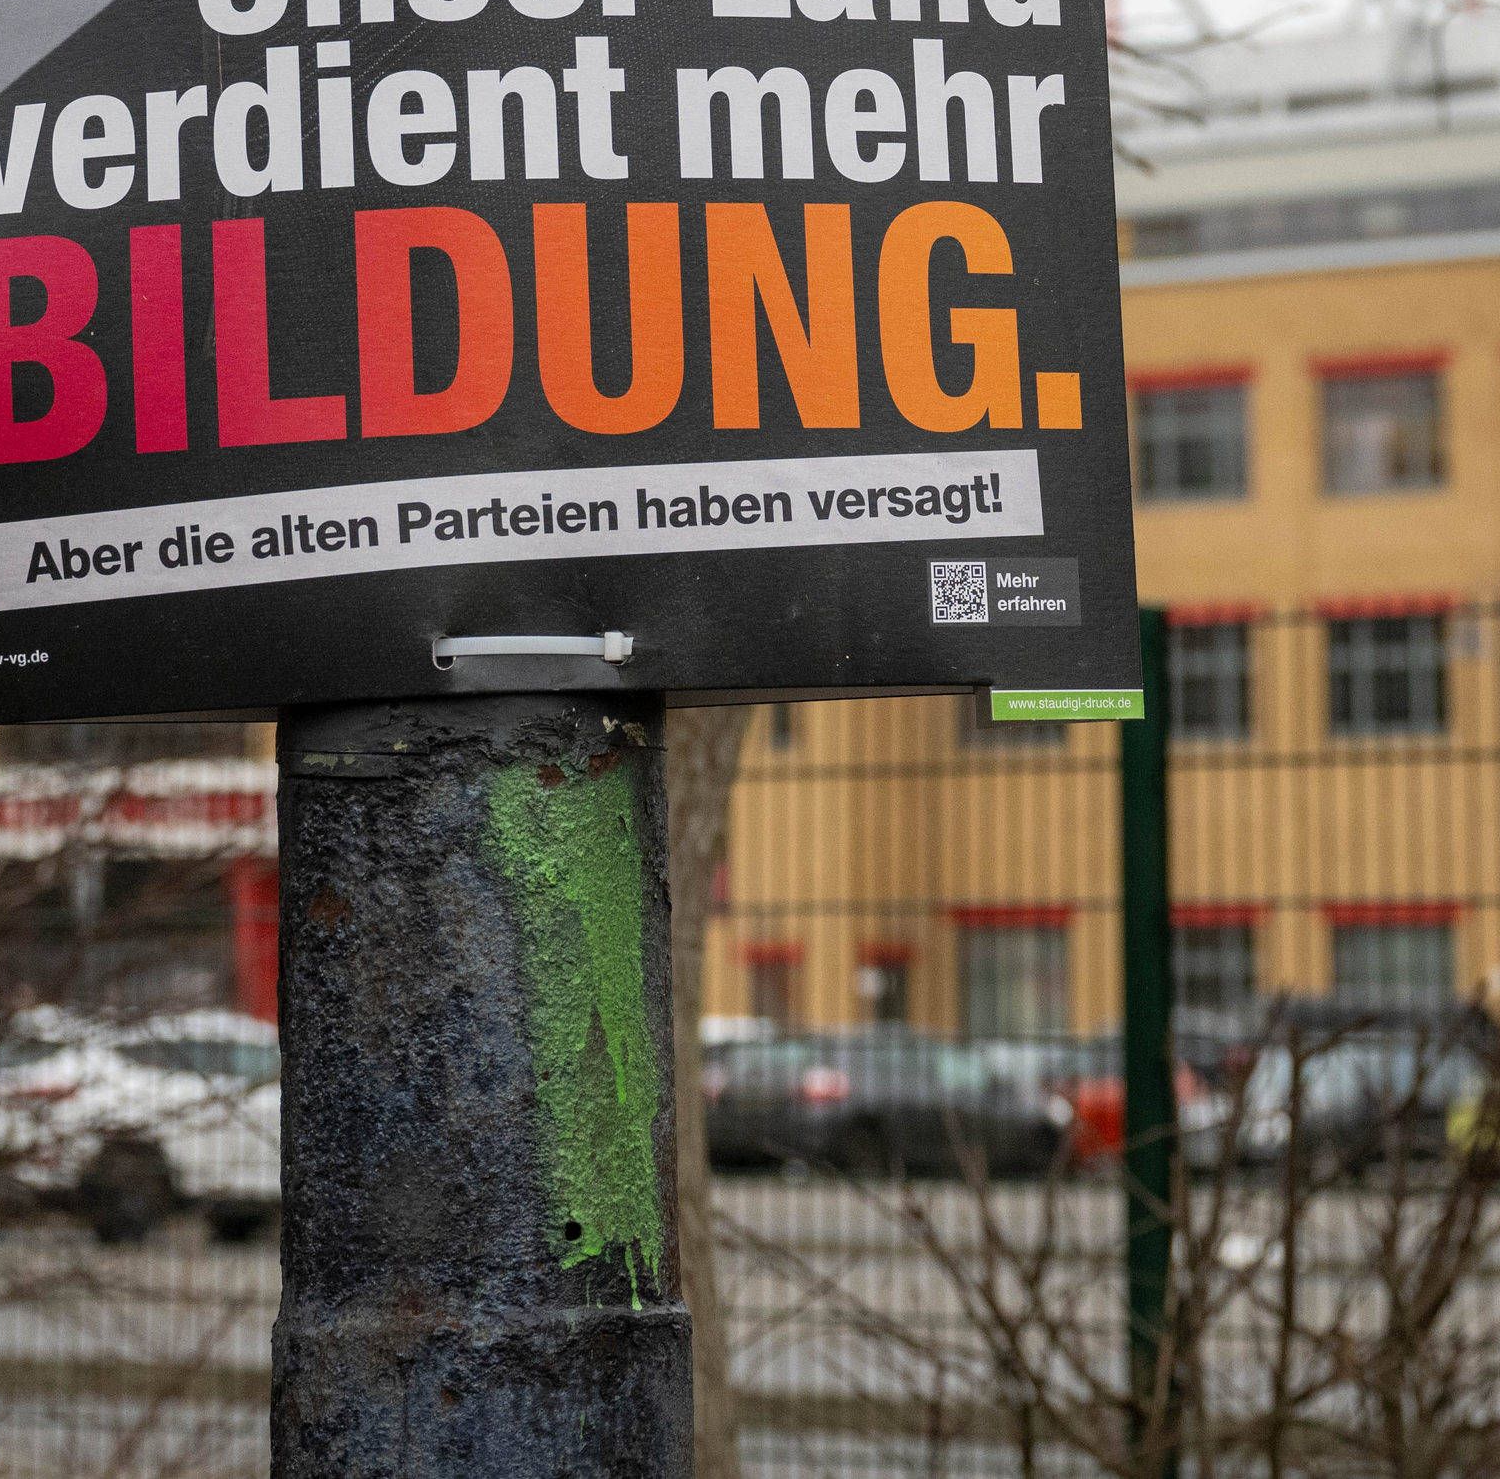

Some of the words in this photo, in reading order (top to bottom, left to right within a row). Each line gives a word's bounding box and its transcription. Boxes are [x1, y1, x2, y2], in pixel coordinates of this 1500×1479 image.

[676, 37, 1066, 185] mehr
[25, 538, 144, 585] Aber
[157, 524, 235, 569] die
[251, 514, 379, 560] alten
[397, 493, 619, 544] Parteien
[636, 485, 793, 530] haben
[807, 472, 1004, 524] versagt!
[996, 572, 1040, 588] Mehr
[997, 595, 1067, 612] erfahren
[1008, 696, 1133, 712] www.staudigl-druck.de
